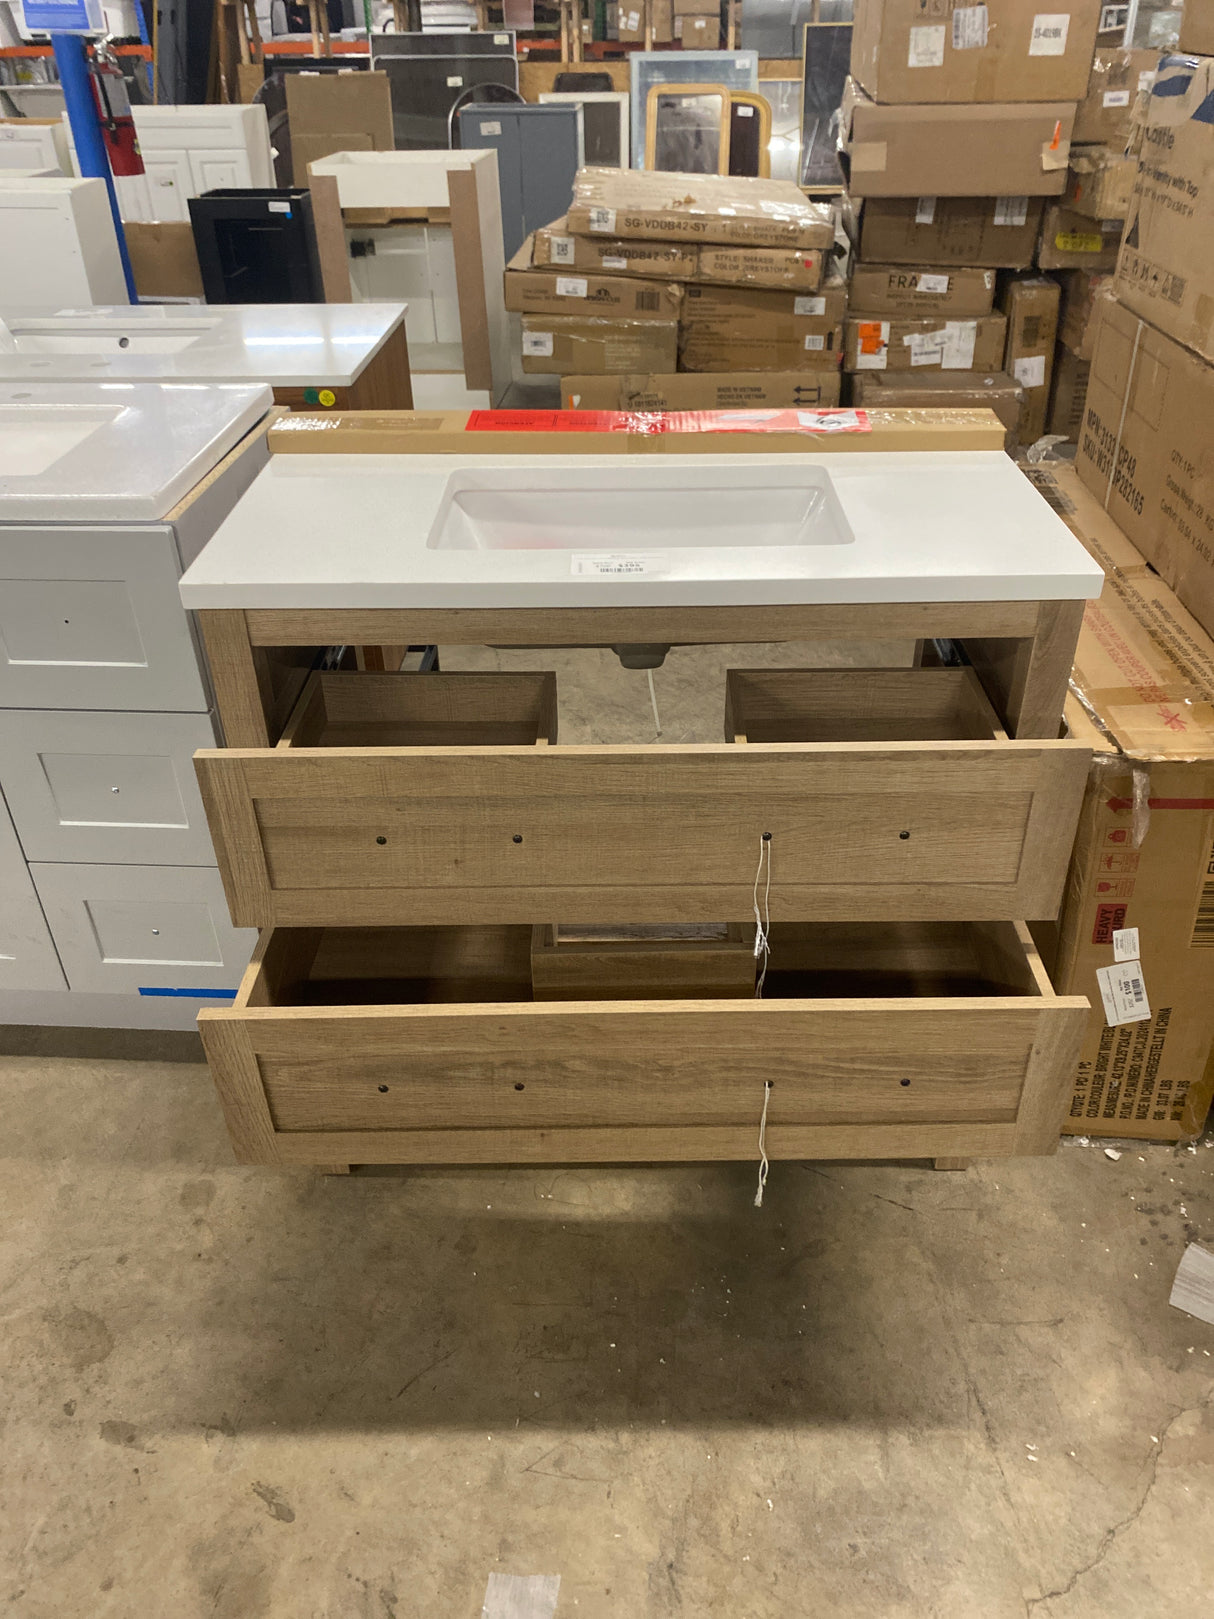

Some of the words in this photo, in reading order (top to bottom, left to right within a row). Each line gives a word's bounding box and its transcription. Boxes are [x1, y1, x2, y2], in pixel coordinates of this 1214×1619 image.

[888, 275, 954, 290] FRAE
[1095, 908, 1113, 944] HEAVY
[1095, 1052, 1110, 1072] BRIGHT
[1136, 1104, 1149, 1119] MADE
[1155, 1008, 1172, 1027] CHINA
[1158, 1080, 1172, 1090] LBS
